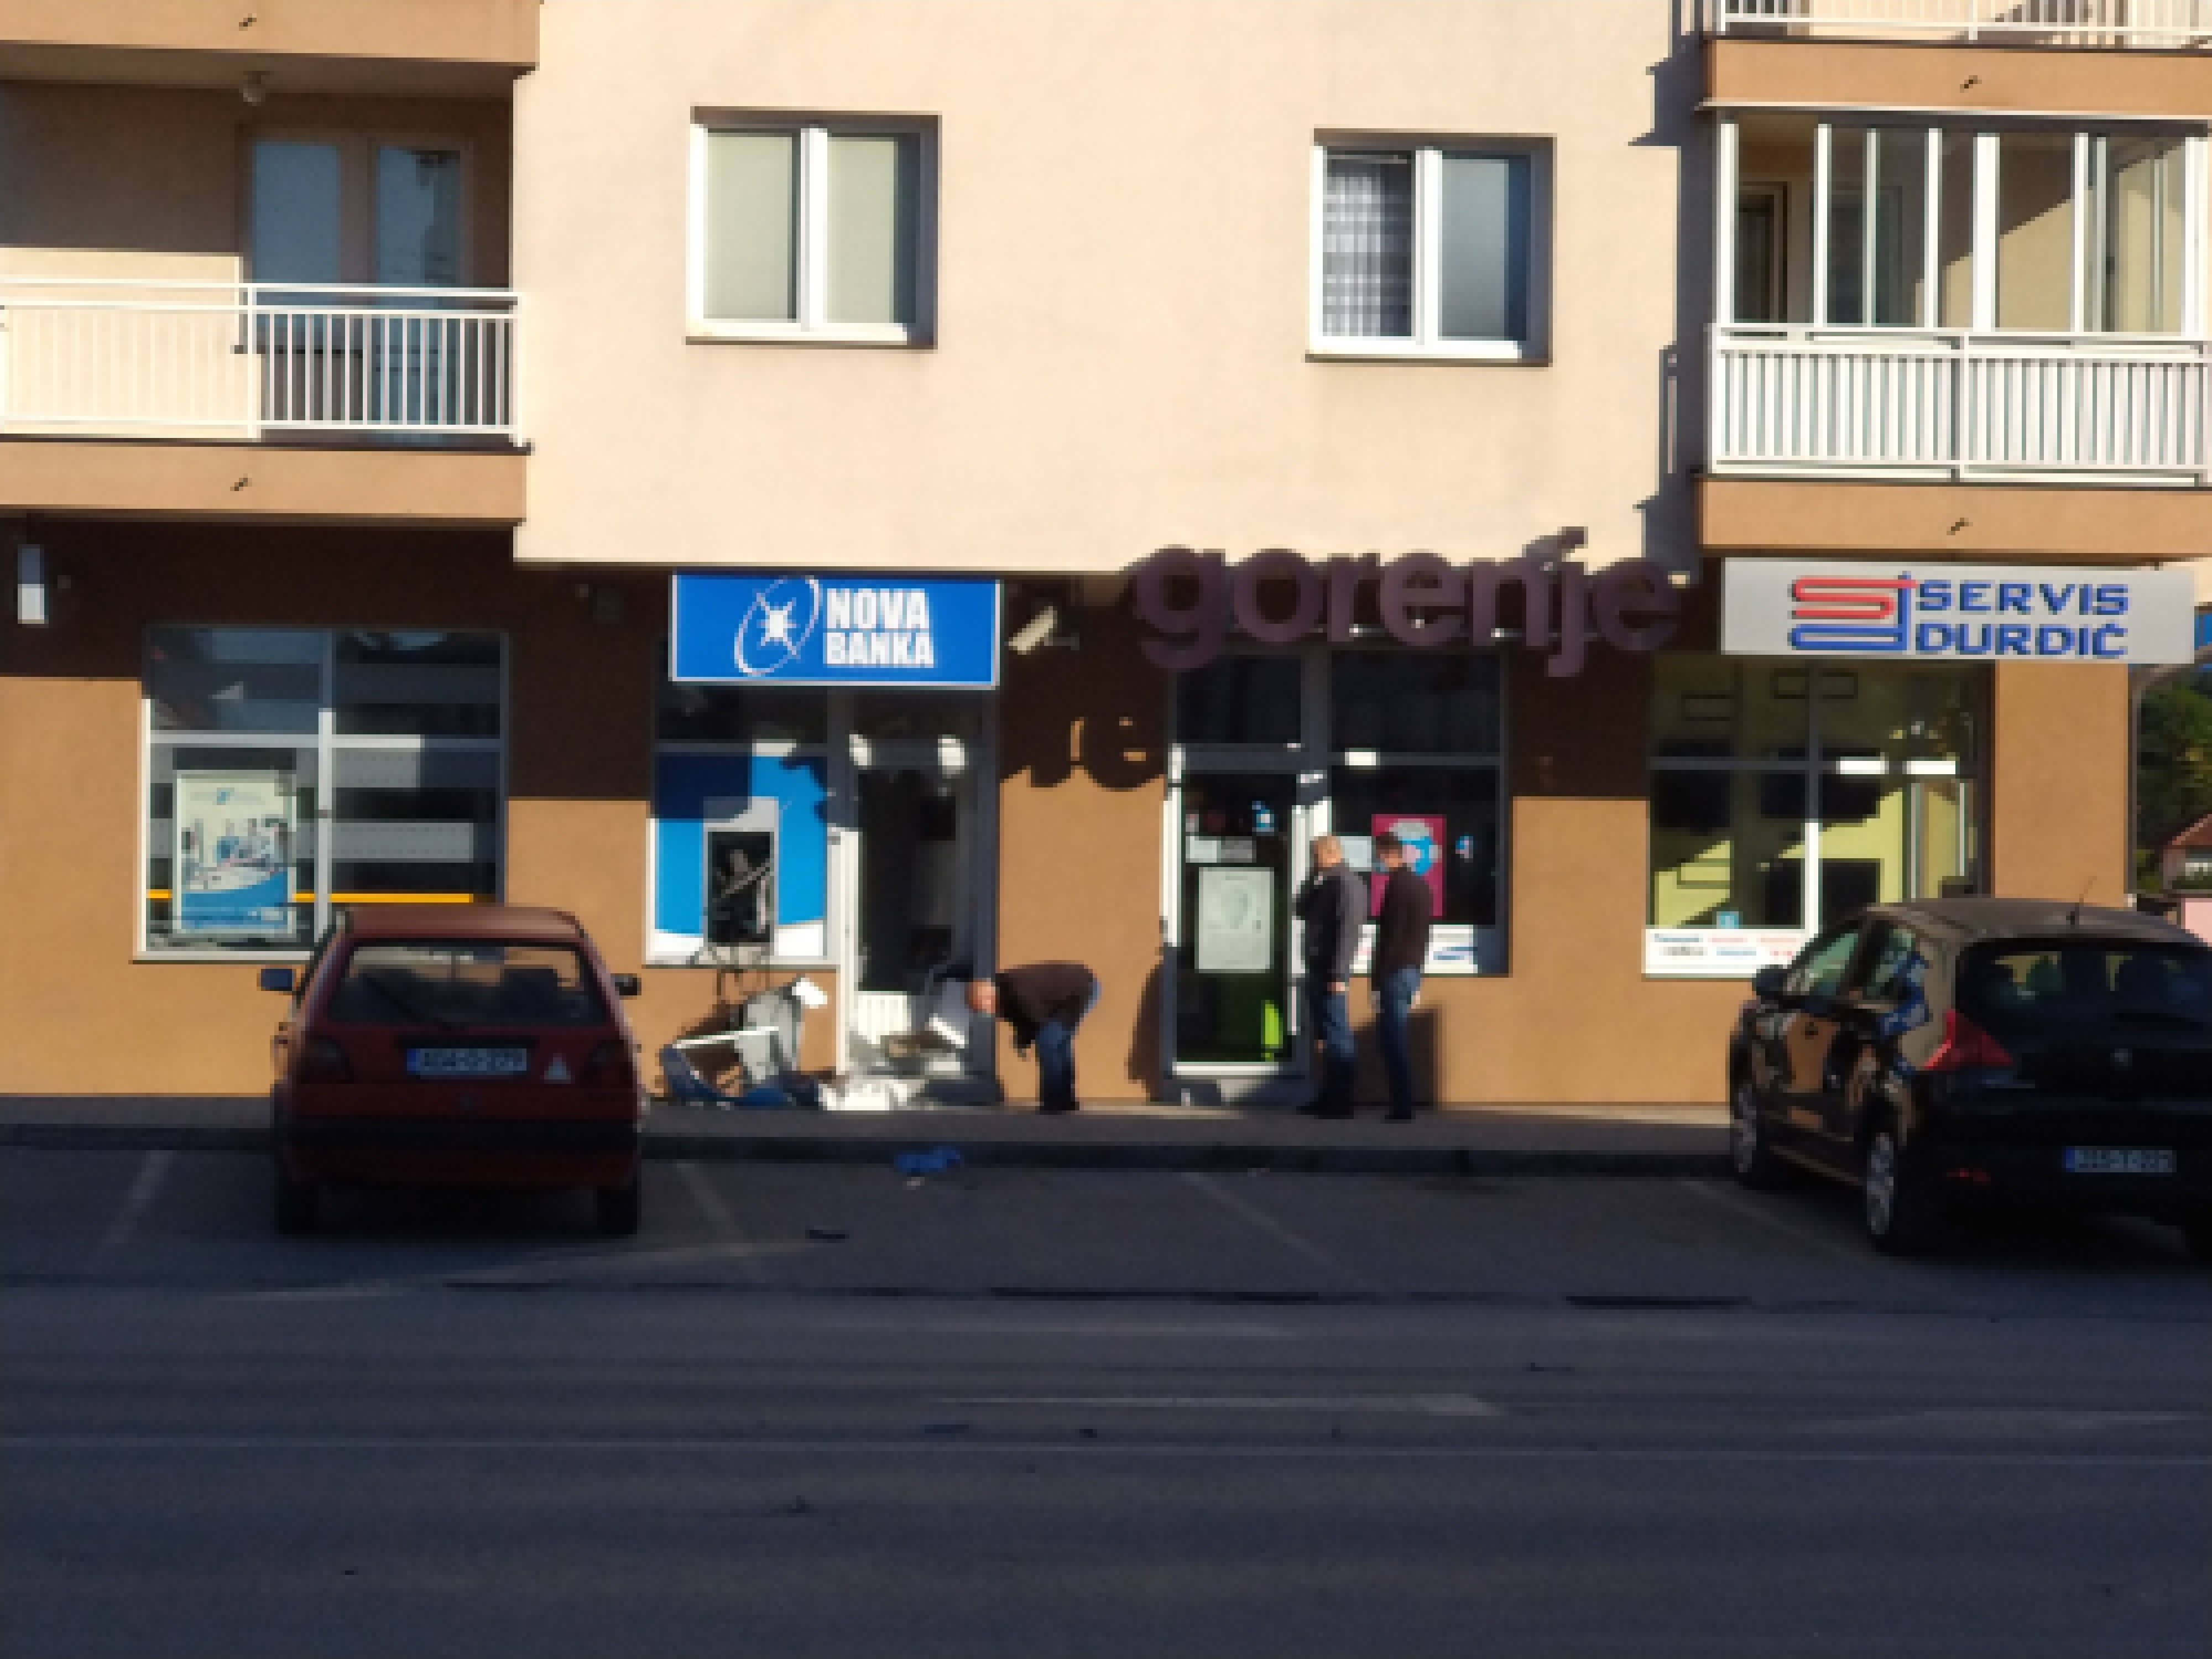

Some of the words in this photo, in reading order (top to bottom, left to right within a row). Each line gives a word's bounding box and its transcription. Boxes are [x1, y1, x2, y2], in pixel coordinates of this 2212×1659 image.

[826, 588, 929, 629] NOVA
[1134, 526, 1681, 676] gorenje
[1917, 580, 2129, 615] SERVIS
[825, 632, 935, 668] BANKA
